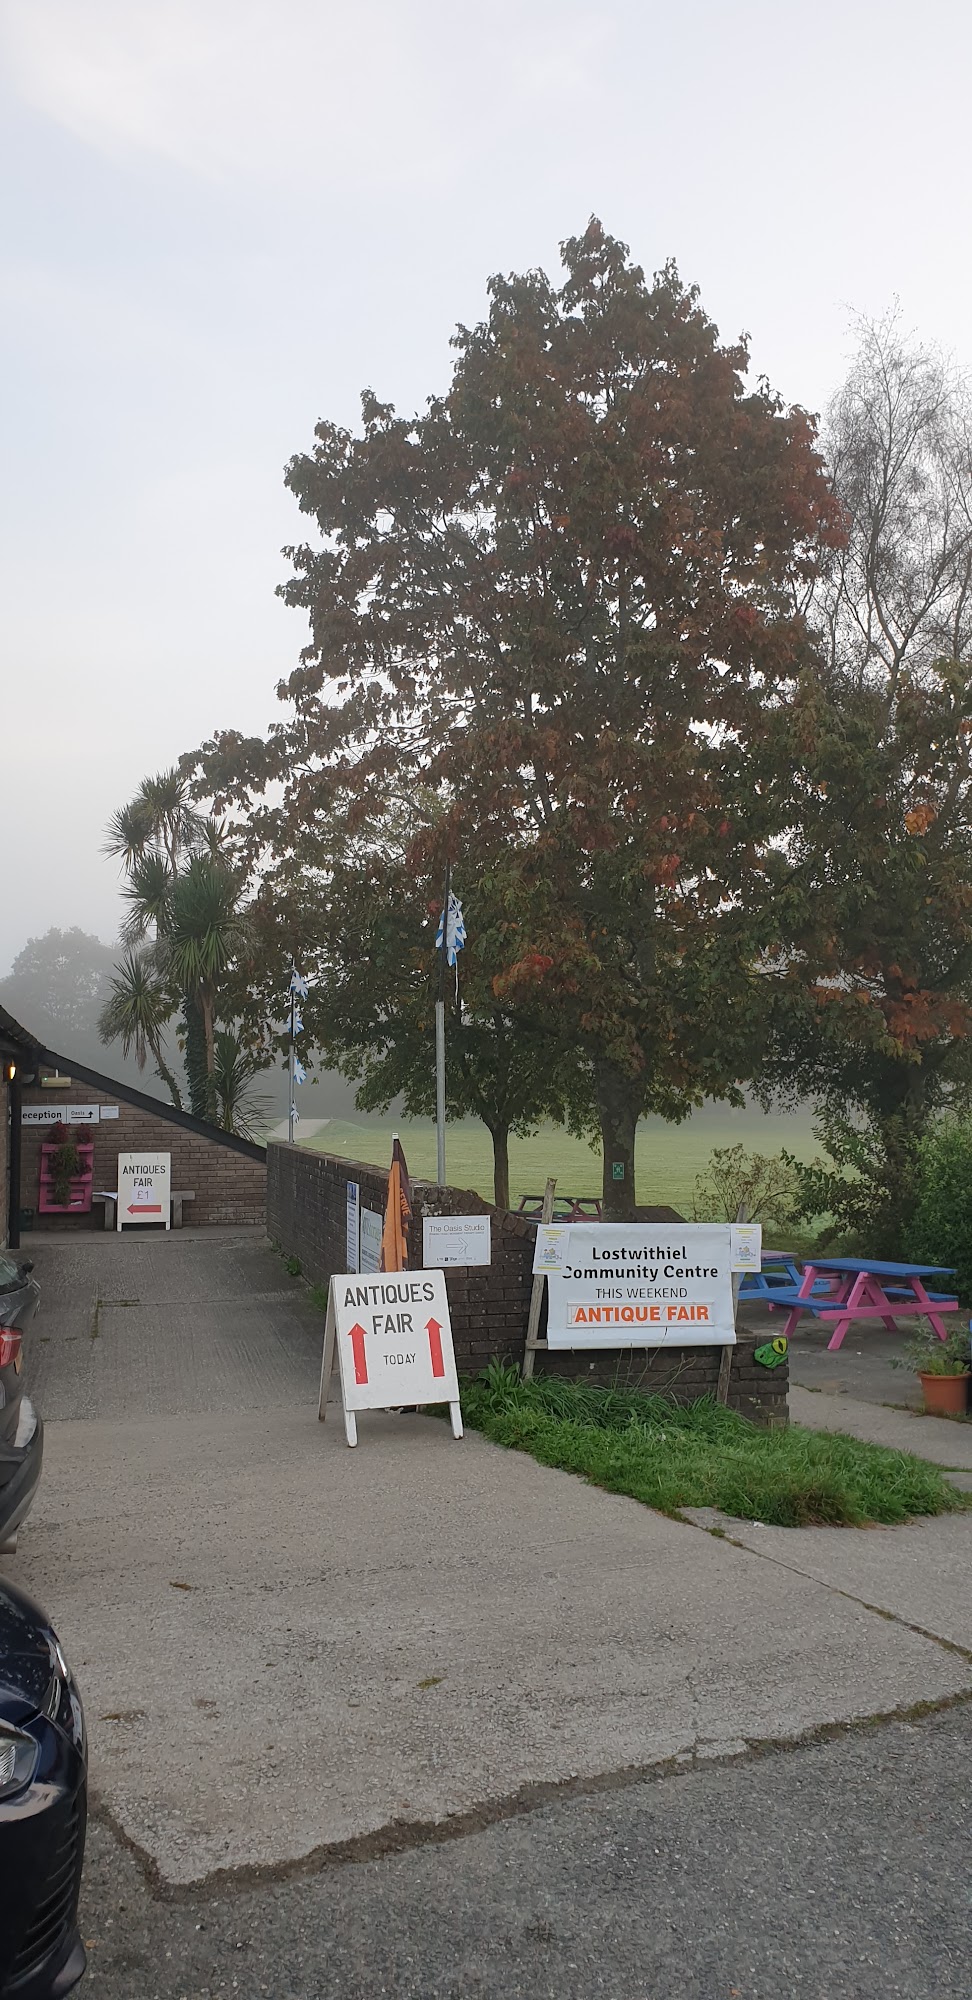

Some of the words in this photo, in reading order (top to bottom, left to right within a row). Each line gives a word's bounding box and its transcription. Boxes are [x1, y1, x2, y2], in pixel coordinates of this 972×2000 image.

[22, 1110, 62, 1120] eception
[122, 1165, 166, 1175] ANTIQUES
[133, 1177, 153, 1187] FAIR
[136, 1190, 149, 1200] £1
[443, 1224, 463, 1232] Oasis
[463, 1223, 485, 1231] Studio
[592, 1245, 688, 1261] Lostwithiel
[663, 1265, 719, 1278] Centre
[344, 1282, 435, 1307] ANTIQUES
[595, 1288, 623, 1299] THIS
[626, 1287, 688, 1299] WEEKEND
[574, 1306, 661, 1322] ANTIQUE
[667, 1305, 709, 1321] FAIR
[372, 1313, 414, 1336] FAIR
[383, 1352, 416, 1366] TODAY
